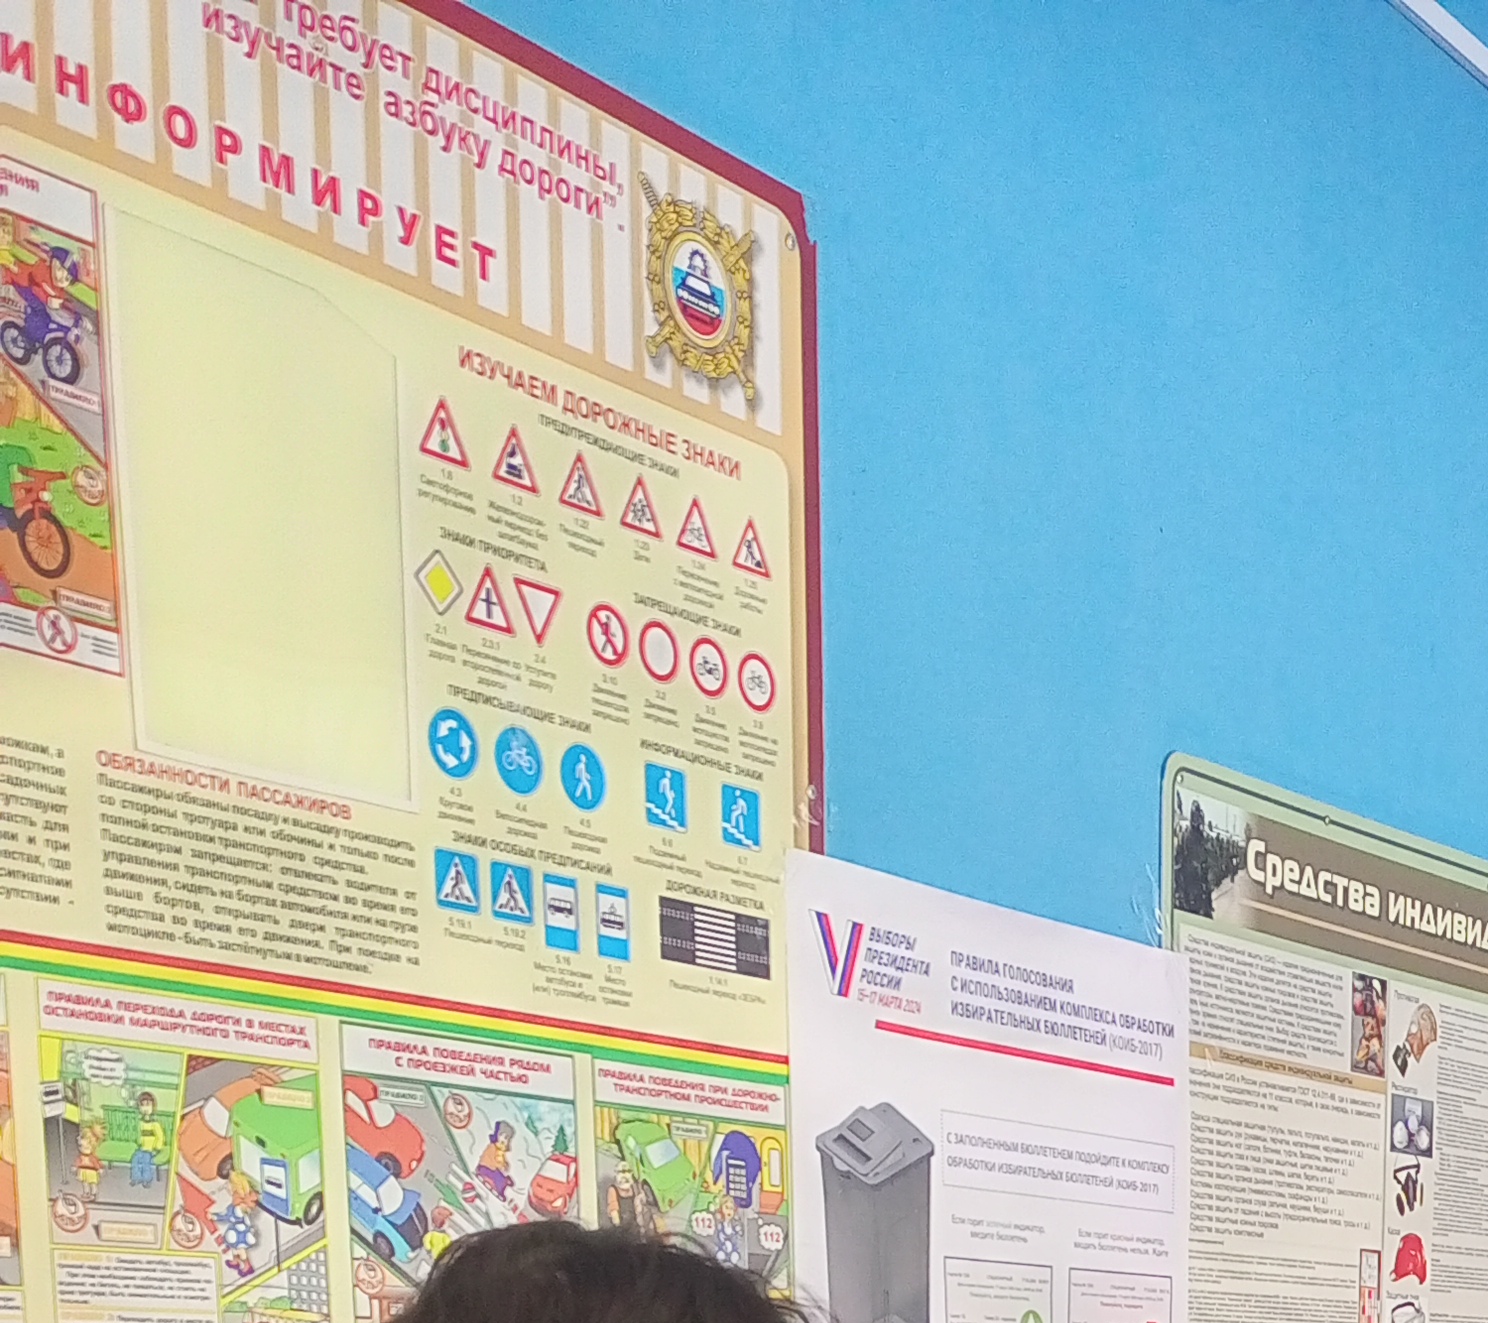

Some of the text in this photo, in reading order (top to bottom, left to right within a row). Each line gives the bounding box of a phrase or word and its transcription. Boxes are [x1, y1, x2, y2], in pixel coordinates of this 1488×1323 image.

[384, 90, 491, 169] азбуку
[422, 66, 624, 196] дисциплины,
[0, 31, 497, 282] ИНФОРМИРУЕТ
[459, 344, 740, 480] ИЗУЧАЕМ ДОРОЖНЫЕ ЗНАКИ
[96, 750, 352, 820] ОБЯЗАННОСТИ ПАССАЖИРОВ
[1246, 839, 1381, 919] Средства
[868, 925, 916, 952] ВЫБОРЫ
[860, 966, 902, 991] РОССИИ
[864, 946, 930, 977] ПРЕЗИДЕНТА
[950, 949, 1074, 995] ПРАВИЛА ГОЛОСОВАНИЯ
[44, 1003, 310, 1050] ОСТАНОВКИ МАРШРУТНОГО ТРАНСПОРТА
[47, 989, 113, 1010] ПРАВИЛА
[116, 999, 186, 1020] ПЕРЕХОДА
[190, 1010, 241, 1028] ДОРОГИ
[258, 1019, 306, 1036] МЕСТАХ
[951, 975, 1174, 1038] С ИСПОЛЬЗОВАНИЕМ КОМПЛЕКСА ОБРАБОТКИ
[951, 1000, 1162, 1061] ИЗБИРАТЕЛЬНЫХ БЮЛЛЕТЕНЕЙ (КОИБ-2017)
[369, 1037, 552, 1074] ПРАВИЛА ПОВЕДЕНИЯ РЯДОМ
[394, 1055, 529, 1084] С ПРОЕЗЖЕЙ ЧАСТЬЮ
[598, 1066, 644, 1083] ПРАВИЛА
[648, 1074, 706, 1093] ПОВЕДЕНИЯ
[708, 1084, 728, 1095] ПРИ
[614, 1083, 769, 1112] ТРАНСПОРТНОМ ПРОИСШЕСТВИИ
[946, 1130, 952, 1144] С
[954, 1132, 1018, 1153] ЗАПОЛНЕННЫМ
[1020, 1142, 1072, 1161] БЮЛЛЕТЕНЕМ
[1075, 1150, 1120, 1168] ПОДОЙДИТЕ
[1121, 1157, 1126, 1168] К
[947, 1155, 996, 1172] ОБРАБОТКИ
[998, 1161, 1062, 1181] ИЗБИРАТЕЛЬНЫХ
[1065, 1170, 1112, 1188] БЮЛЛЕТЕНЕЙ
[694, 1216, 713, 1230] 112
[763, 1230, 781, 1243] 112
